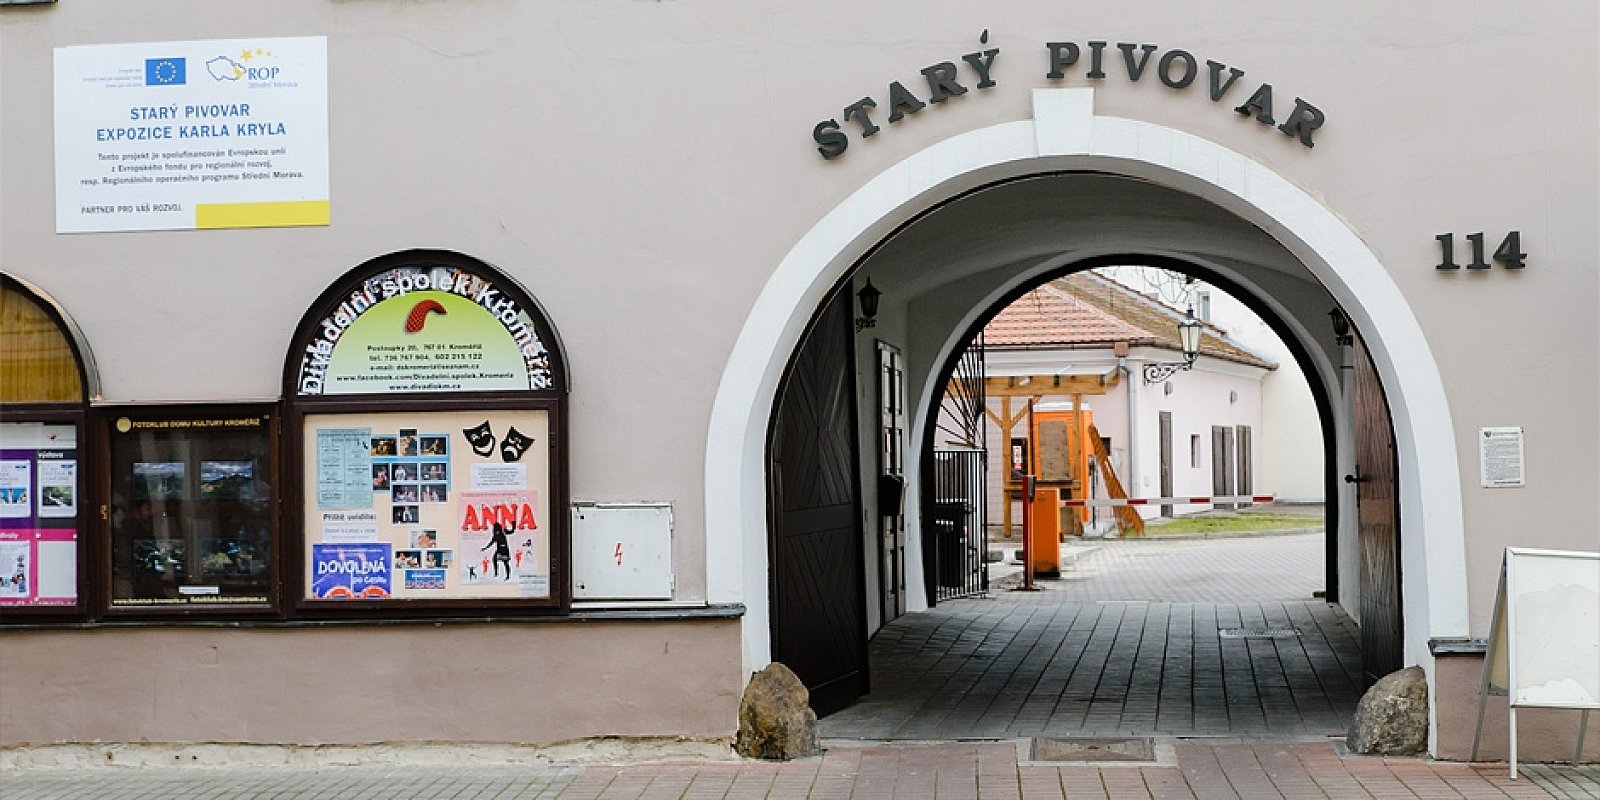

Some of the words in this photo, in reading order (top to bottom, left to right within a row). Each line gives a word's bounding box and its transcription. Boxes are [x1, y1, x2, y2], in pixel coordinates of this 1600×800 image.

[248, 67, 280, 80] ROP
[813, 28, 1000, 160] STARÝ
[1046, 41, 1327, 149] PIVOVAR
[130, 102, 178, 120] STARÝ
[185, 103, 250, 119] PIVOVAR
[96, 126, 172, 141] EXPOZICE
[179, 124, 229, 138] KARLA
[236, 122, 287, 136] KRYLA
[122, 152, 149, 162] projekt
[151, 152, 160, 161] je
[162, 150, 225, 160] spolufinancován
[227, 148, 268, 157] Evropskou
[270, 147, 286, 155] unii
[118, 164, 162, 173] Evropského
[164, 163, 187, 171] fondu
[190, 162, 203, 170] pro
[205, 161, 245, 170] regionální
[101, 176, 153, 185] Regionálního
[155, 174, 200, 183] operačního
[201, 174, 239, 182] programu
[241, 172, 270, 180] Střední
[273, 171, 304, 179] Morava.
[81, 205, 114, 214] PARTNER
[117, 205, 134, 213] PRO
[135, 203, 150, 212] VÁŠ
[1434, 230, 1528, 271] 114
[301, 279, 380, 394] Divadelní
[382, 268, 470, 297] spolek
[192, 419, 223, 428] KULTURY
[460, 503, 538, 531] ANNA
[318, 556, 386, 574] DOVOLENÁ
